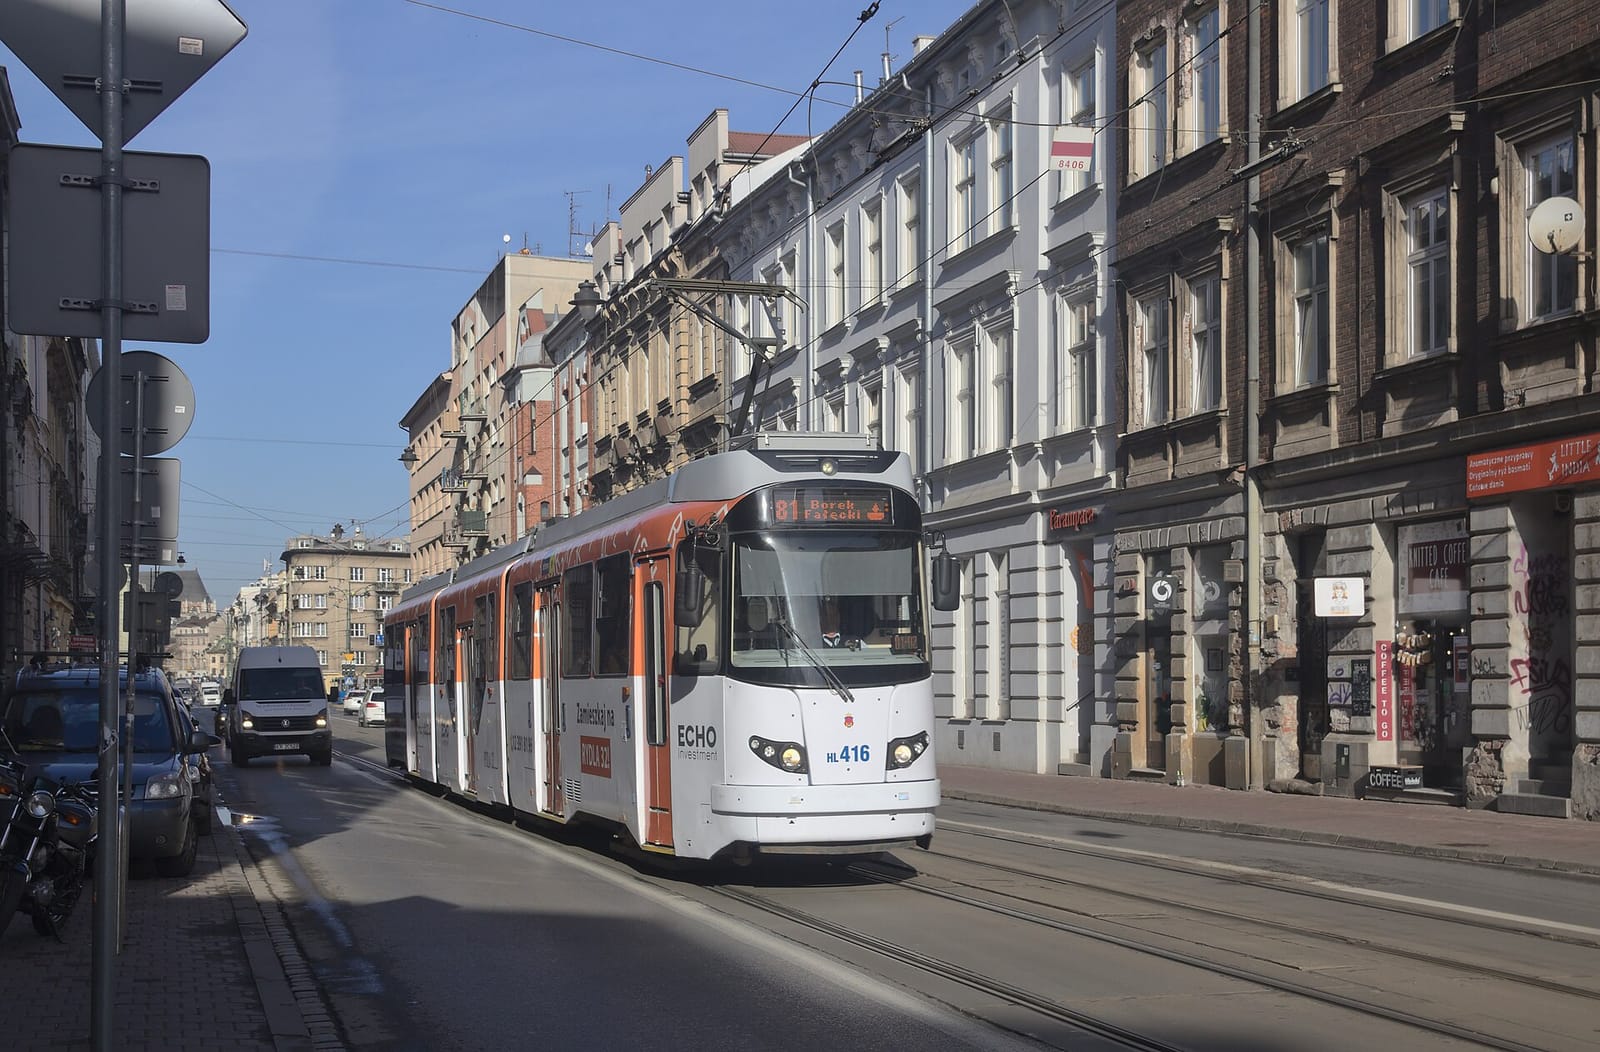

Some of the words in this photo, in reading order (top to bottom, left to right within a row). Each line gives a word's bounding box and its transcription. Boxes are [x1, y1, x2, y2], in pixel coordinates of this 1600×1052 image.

[1058, 160, 1084, 169] 8406
[1560, 439, 1592, 458] LITTLE
[1508, 462, 1531, 474] basmati
[1561, 461, 1591, 477] INDIA
[776, 500, 798, 520] 81
[811, 500, 854, 509] Borek
[1050, 508, 1095, 530] Parampara
[1408, 544, 1438, 568] KNITTED
[1429, 567, 1449, 588] CAFE
[1380, 643, 1388, 695] COFFEE
[576, 702, 606, 733] Zamieszkaj
[607, 709, 615, 727] na
[1381, 700, 1388, 716] TO
[677, 725, 717, 748] ECHO
[1381, 721, 1388, 738] GO
[1370, 773, 1402, 788] COFFEE
